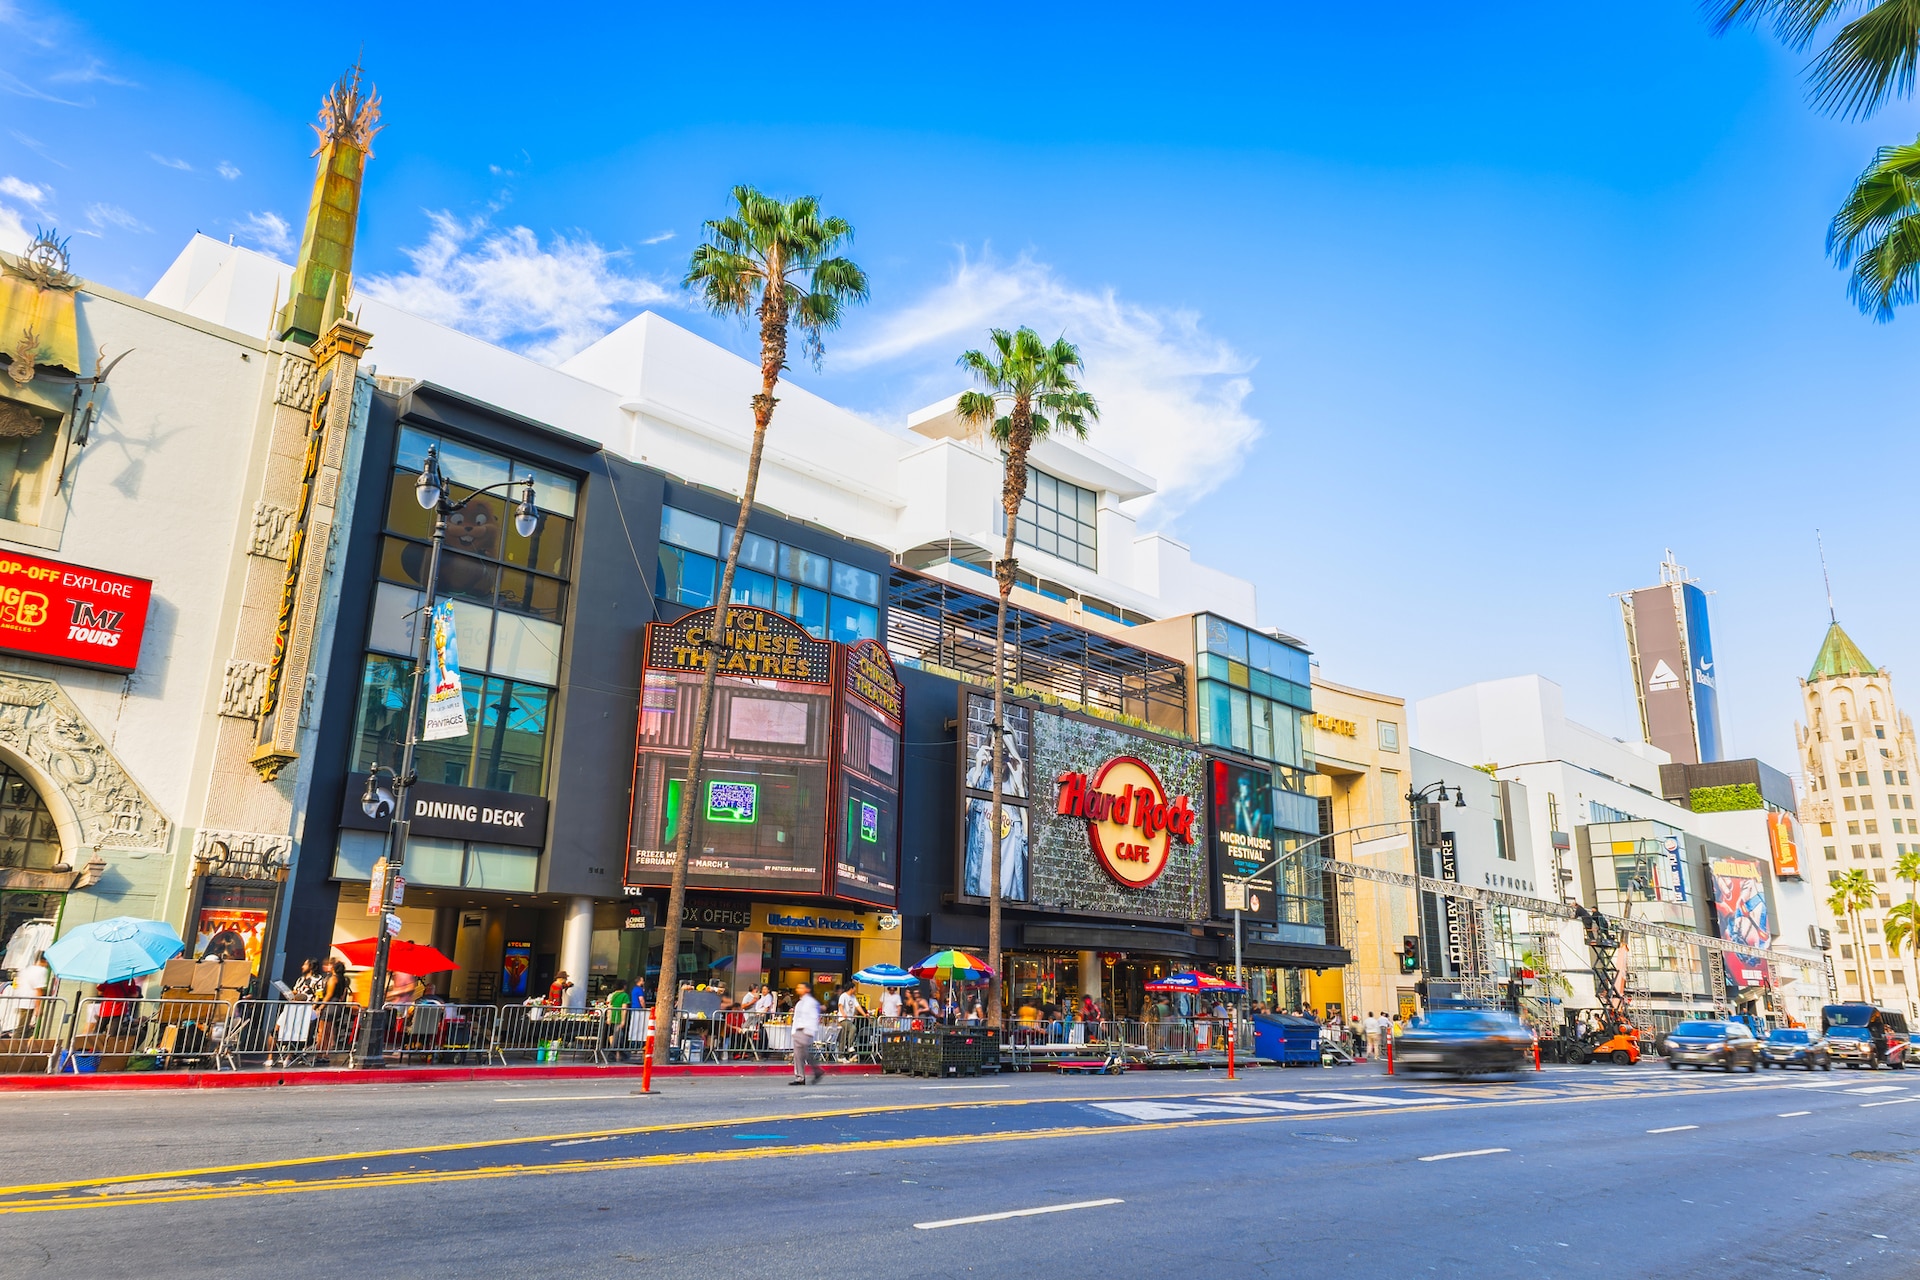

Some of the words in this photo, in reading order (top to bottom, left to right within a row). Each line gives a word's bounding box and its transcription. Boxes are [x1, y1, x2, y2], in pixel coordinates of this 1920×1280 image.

[262, 390, 329, 715] CHINESE
[0, 560, 61, 582] OP-OFF
[62, 573, 133, 598] EXPLORE
[0, 585, 20, 605] IG
[66, 598, 125, 632] TMZ
[725, 610, 769, 632] TCL
[67, 626, 121, 647] TOURS
[860, 657, 896, 695] CHINESE
[427, 715, 463, 728] PANTAGES
[1313, 713, 1357, 737] HEATRE
[415, 800, 477, 822] DINING
[481, 807, 525, 828] DECK
[1057, 771, 1134, 826] Hard
[1134, 787, 1195, 845] Rock
[1220, 831, 1246, 845] MICRO
[1247, 836, 1271, 850] MUSIC
[636, 850, 664, 859] FRIEZE
[666, 851, 677, 859] WE
[1116, 842, 1150, 863] CAFE
[1228, 845, 1265, 862] FESTIVAL
[1442, 839, 1456, 883] EATRE
[636, 858, 676, 866] FEBRUARY
[695, 860, 722, 868] MARCH
[623, 887, 642, 895] TCL
[1485, 872, 1534, 892] SEPHORA
[682, 907, 698, 921] OX
[704, 909, 751, 924] OFFICE
[767, 913, 816, 929] Wetzel's
[818, 918, 864, 931] Pretzels
[200, 920, 259, 933] IMAX
